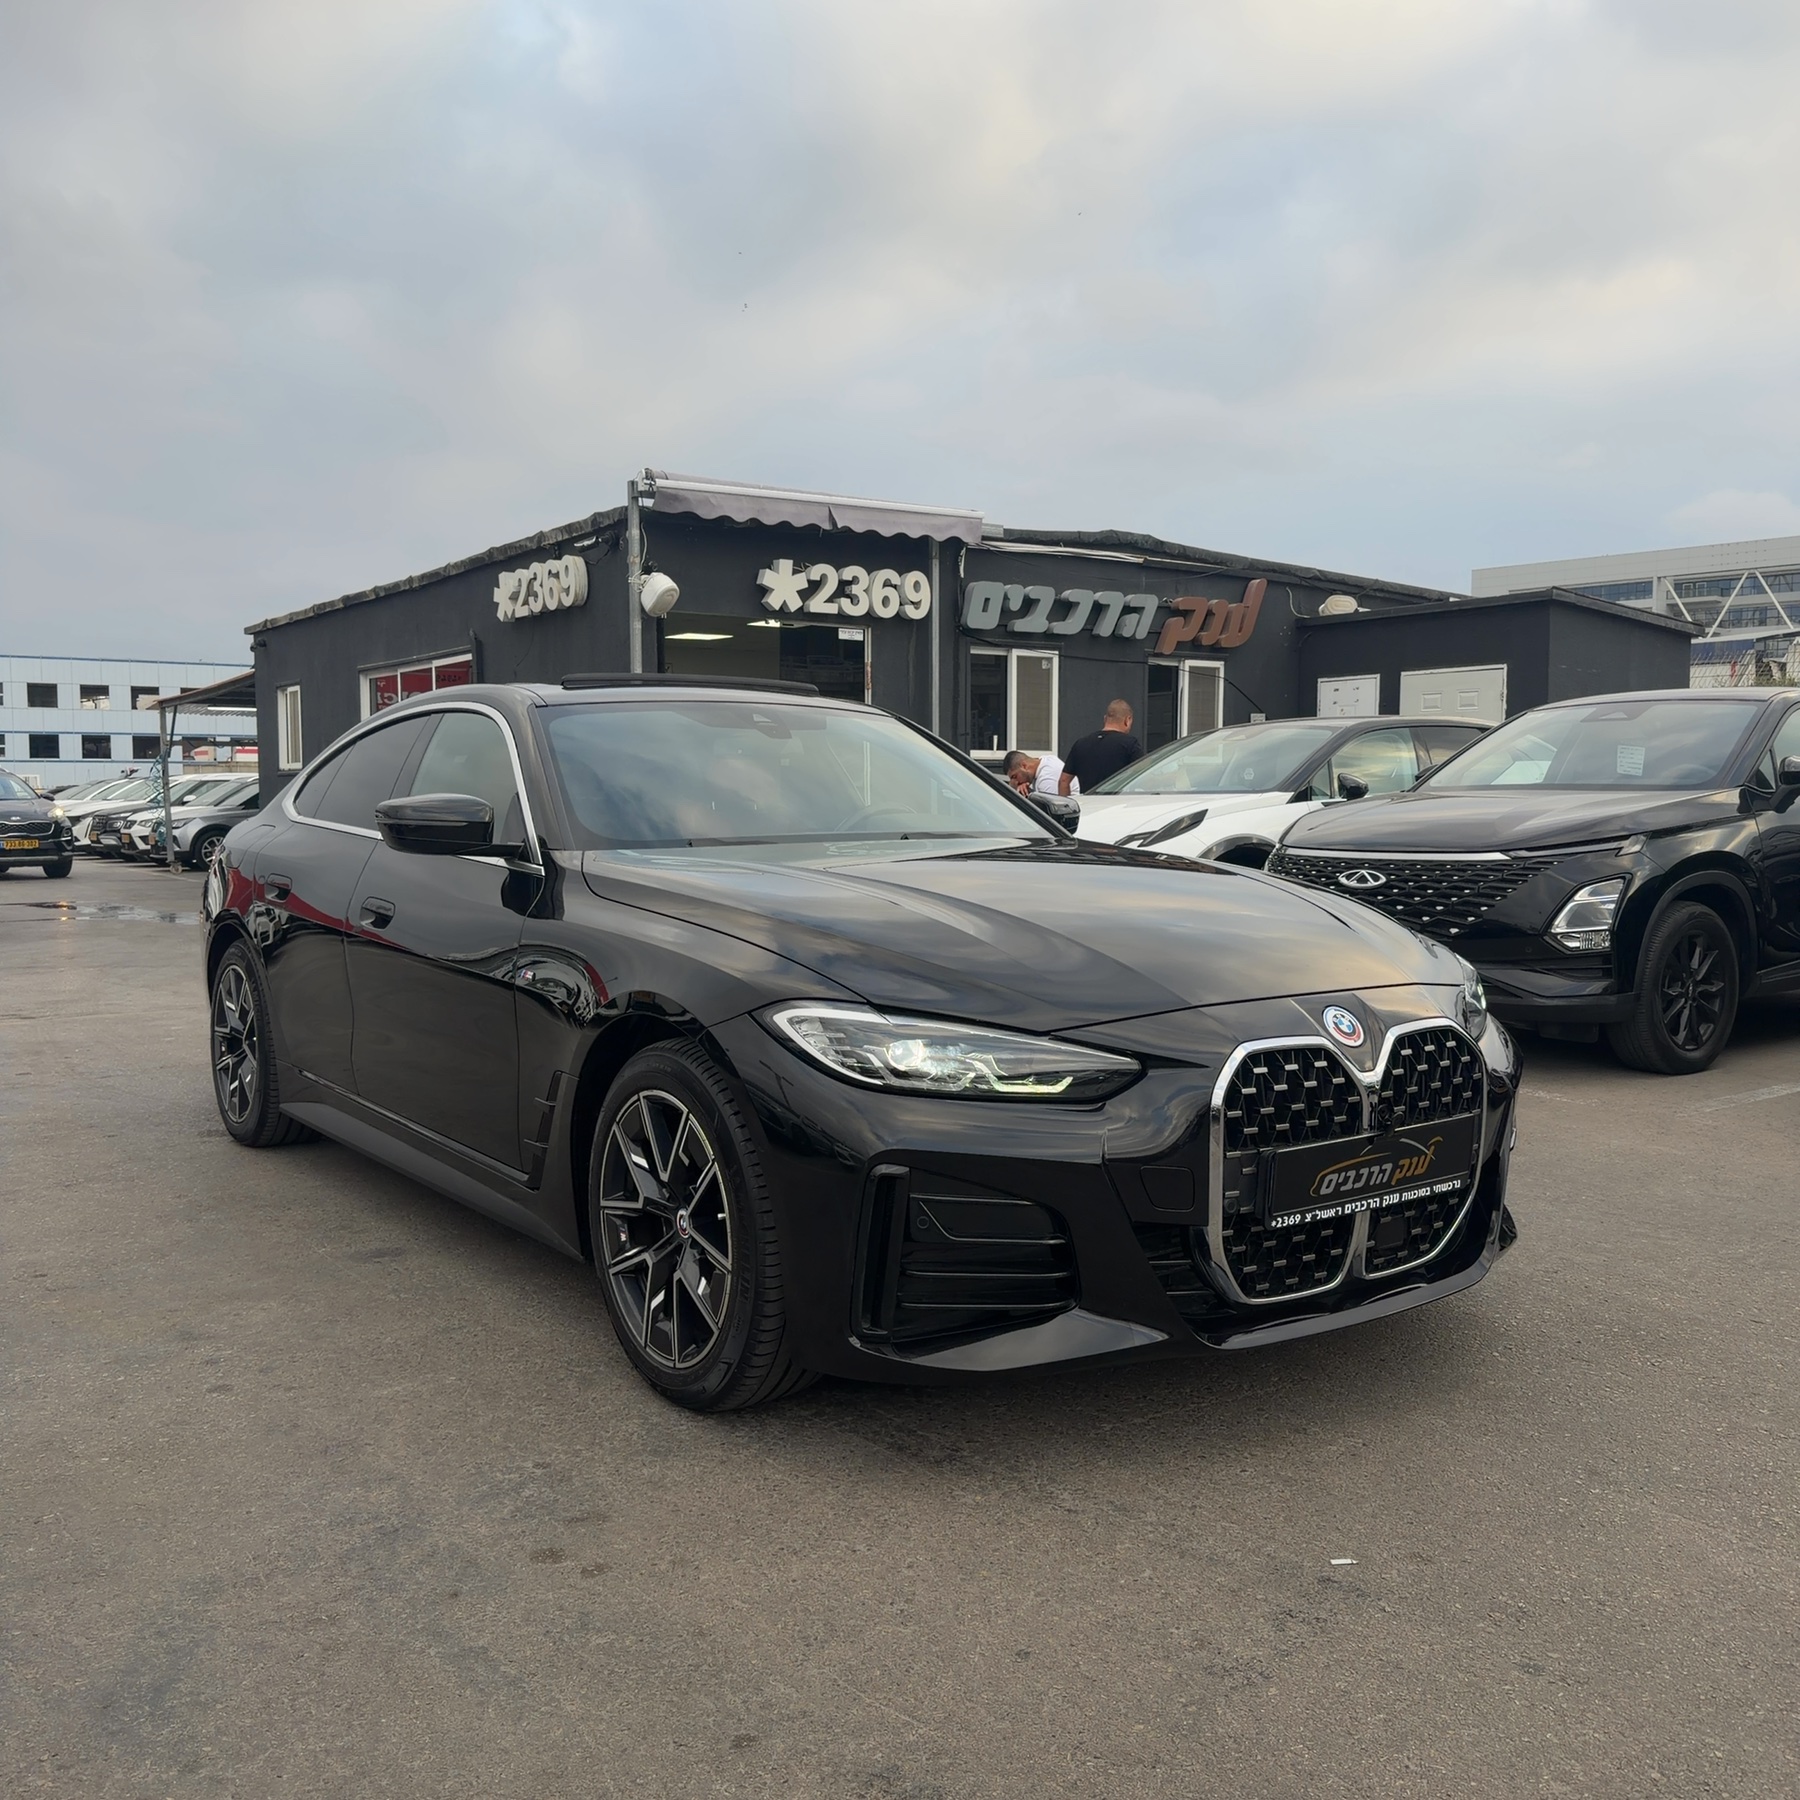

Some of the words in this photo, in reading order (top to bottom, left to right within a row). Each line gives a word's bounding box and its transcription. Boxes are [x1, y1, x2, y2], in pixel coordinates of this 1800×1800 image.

[960, 580, 1159, 640] הרכבים
[1154, 578, 1268, 655] ענק
[1391, 1142, 1437, 1186] ענק
[1319, 1162, 1393, 1195] הרכבים
[1433, 1179, 1461, 1194] נרכשתי
[1344, 1197, 1380, 1214] הרכבים
[1382, 1193, 1400, 1207] ענק
[1401, 1187, 1431, 1201] בסוכנות
